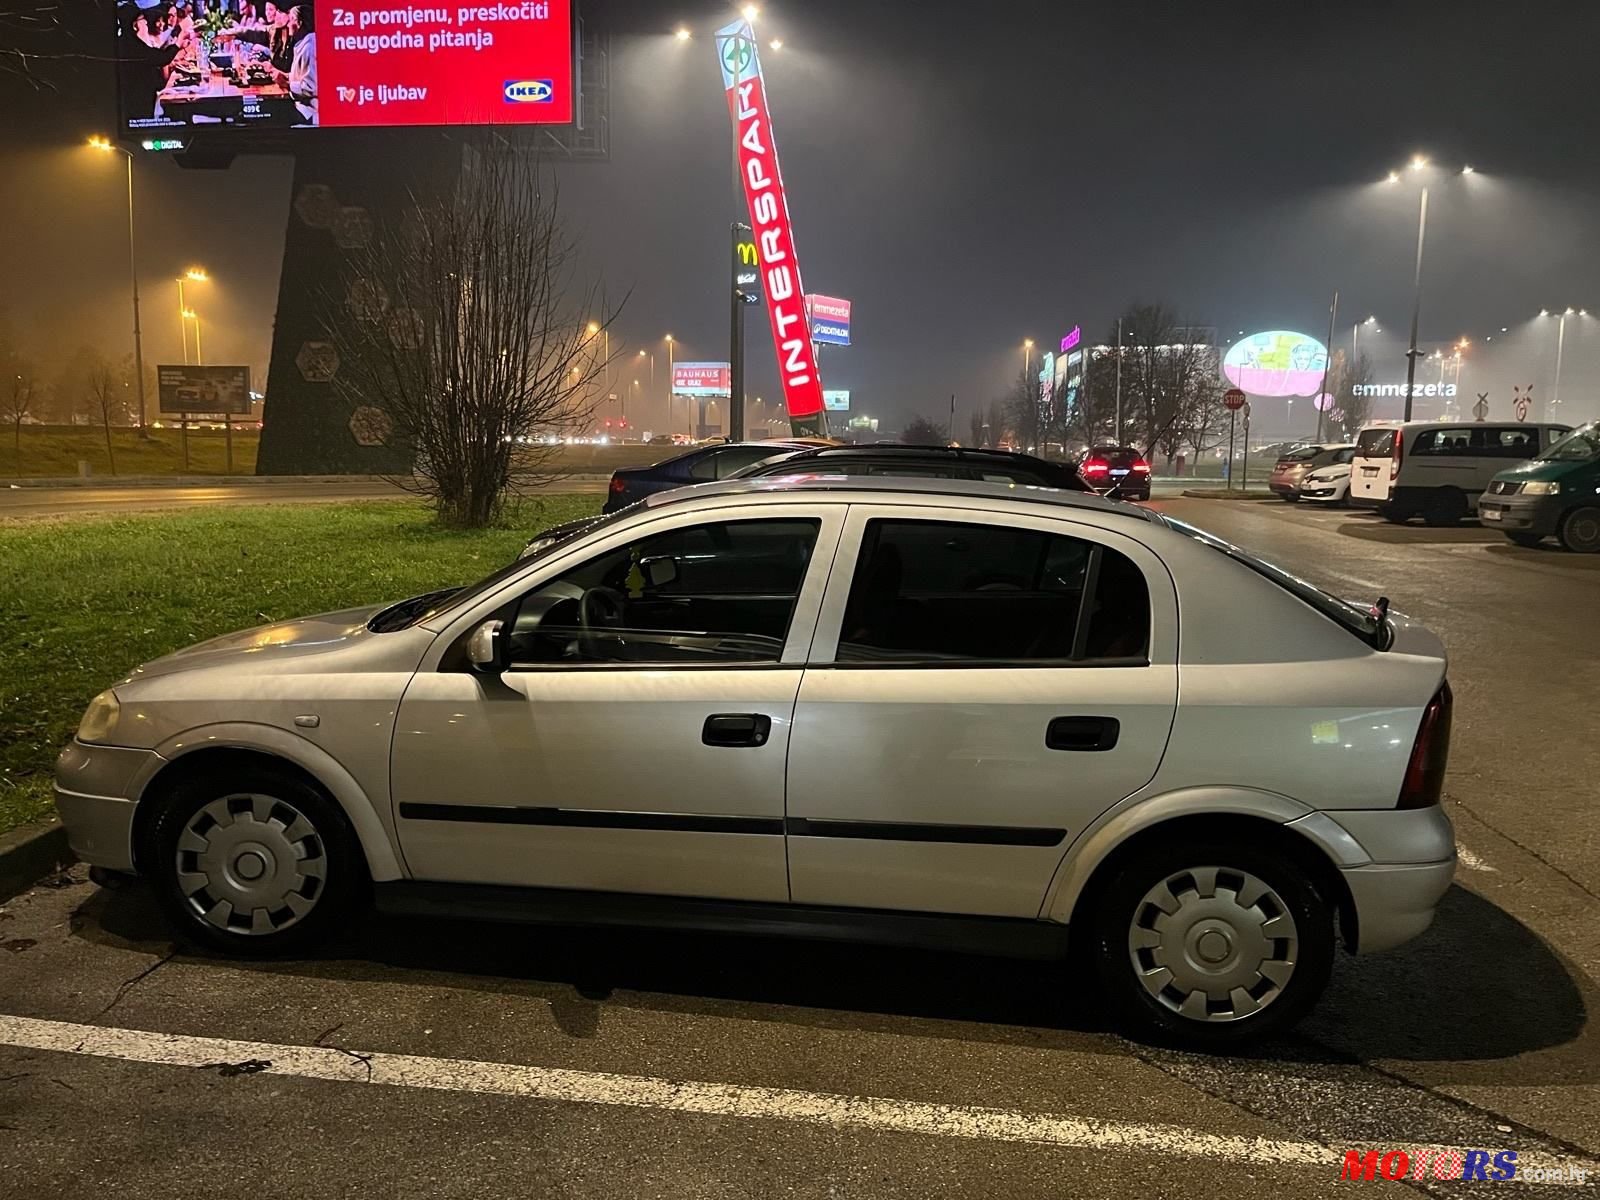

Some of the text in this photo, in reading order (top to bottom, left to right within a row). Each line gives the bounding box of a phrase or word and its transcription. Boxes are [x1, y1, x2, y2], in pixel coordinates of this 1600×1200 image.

[333, 2, 549, 29] Za promjenu, preskočiti
[334, 29, 493, 54] neugodna pitanja
[358, 86, 374, 105] je
[378, 85, 427, 103] ljubav
[509, 87, 548, 96] IKEA
[160, 140, 184, 150] DIGITAL
[738, 82, 811, 386] INTERSPAR
[814, 303, 849, 317] emmezeta
[820, 325, 849, 337] DECATHLON
[676, 369, 720, 378] BAUHAUS
[1225, 394, 1245, 404] STOP
